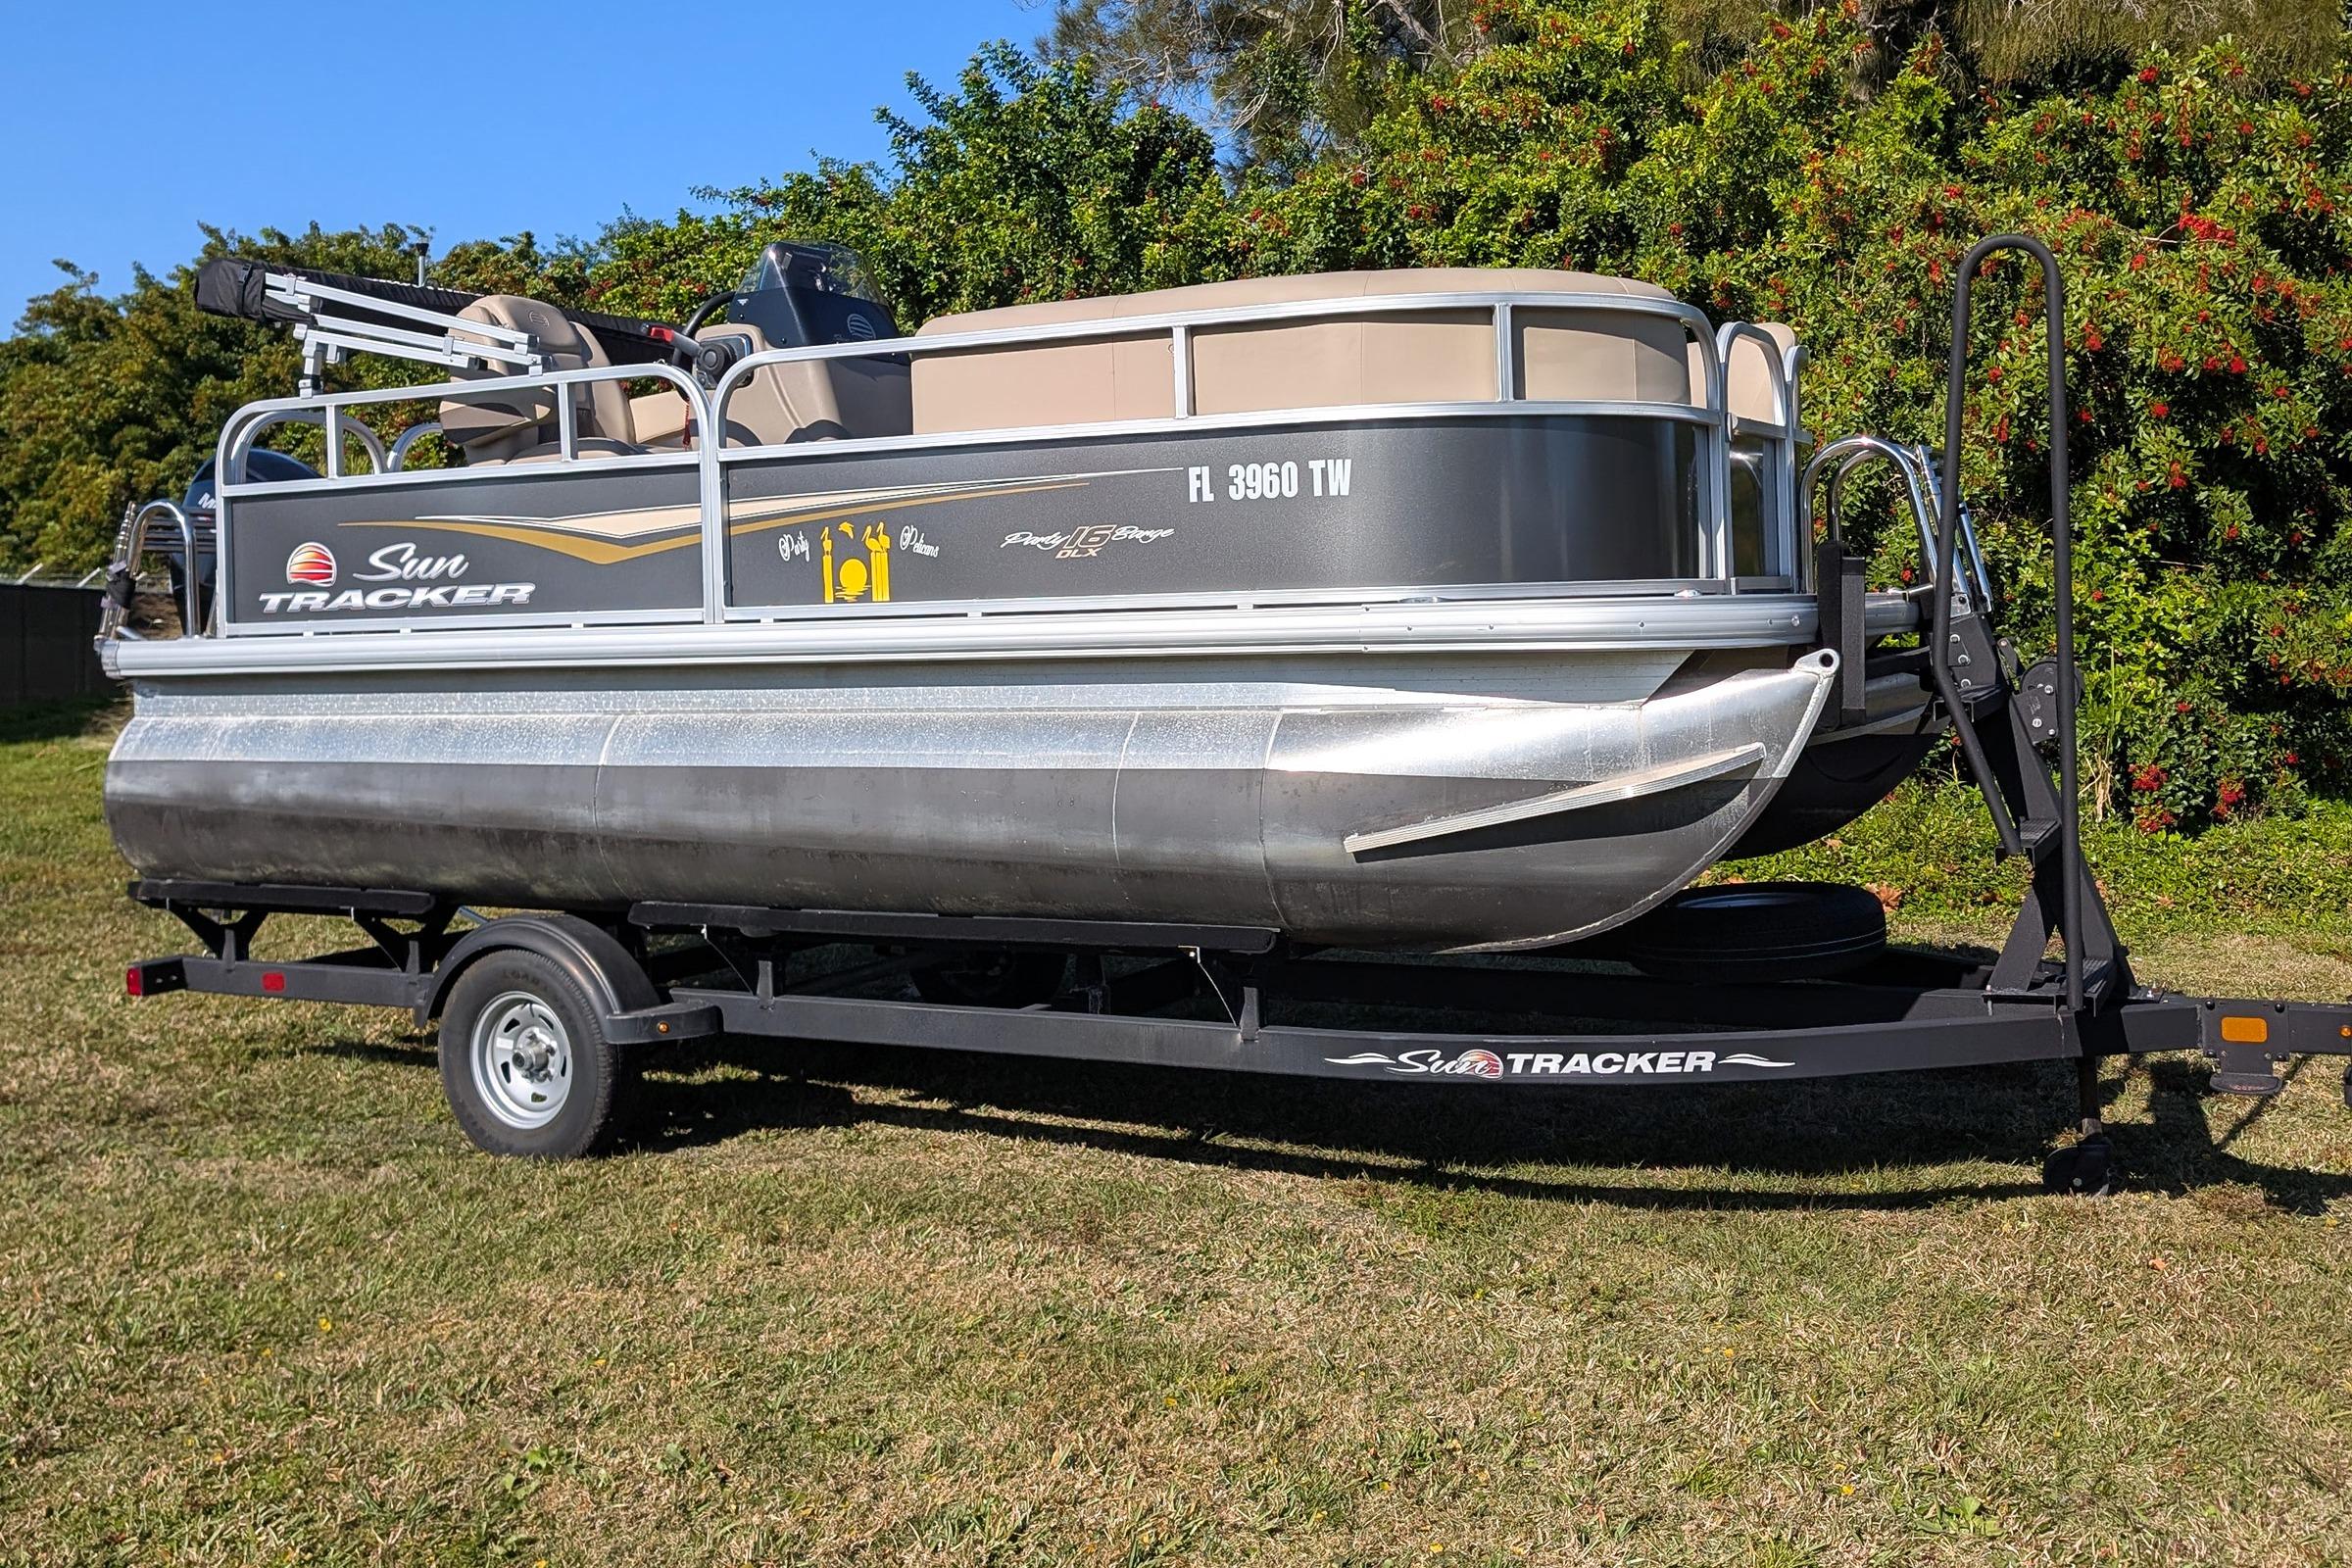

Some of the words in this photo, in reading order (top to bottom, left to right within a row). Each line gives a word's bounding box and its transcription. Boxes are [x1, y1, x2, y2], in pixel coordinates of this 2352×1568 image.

[1188, 466, 1215, 503] FL
[1228, 461, 1298, 501] 3960
[1308, 459, 1352, 497] TW
[778, 530, 811, 563] Party
[899, 524, 941, 559] Pelicans
[1000, 531, 1071, 551] Party
[1062, 524, 1118, 549] 16
[1110, 525, 1175, 544] Barge
[1054, 547, 1103, 560] DLX
[352, 541, 470, 582] Sun
[258, 582, 537, 614] TRACKER
[1385, 1049, 1494, 1076] Sun
[1506, 1052, 1717, 1074] TRACKER
